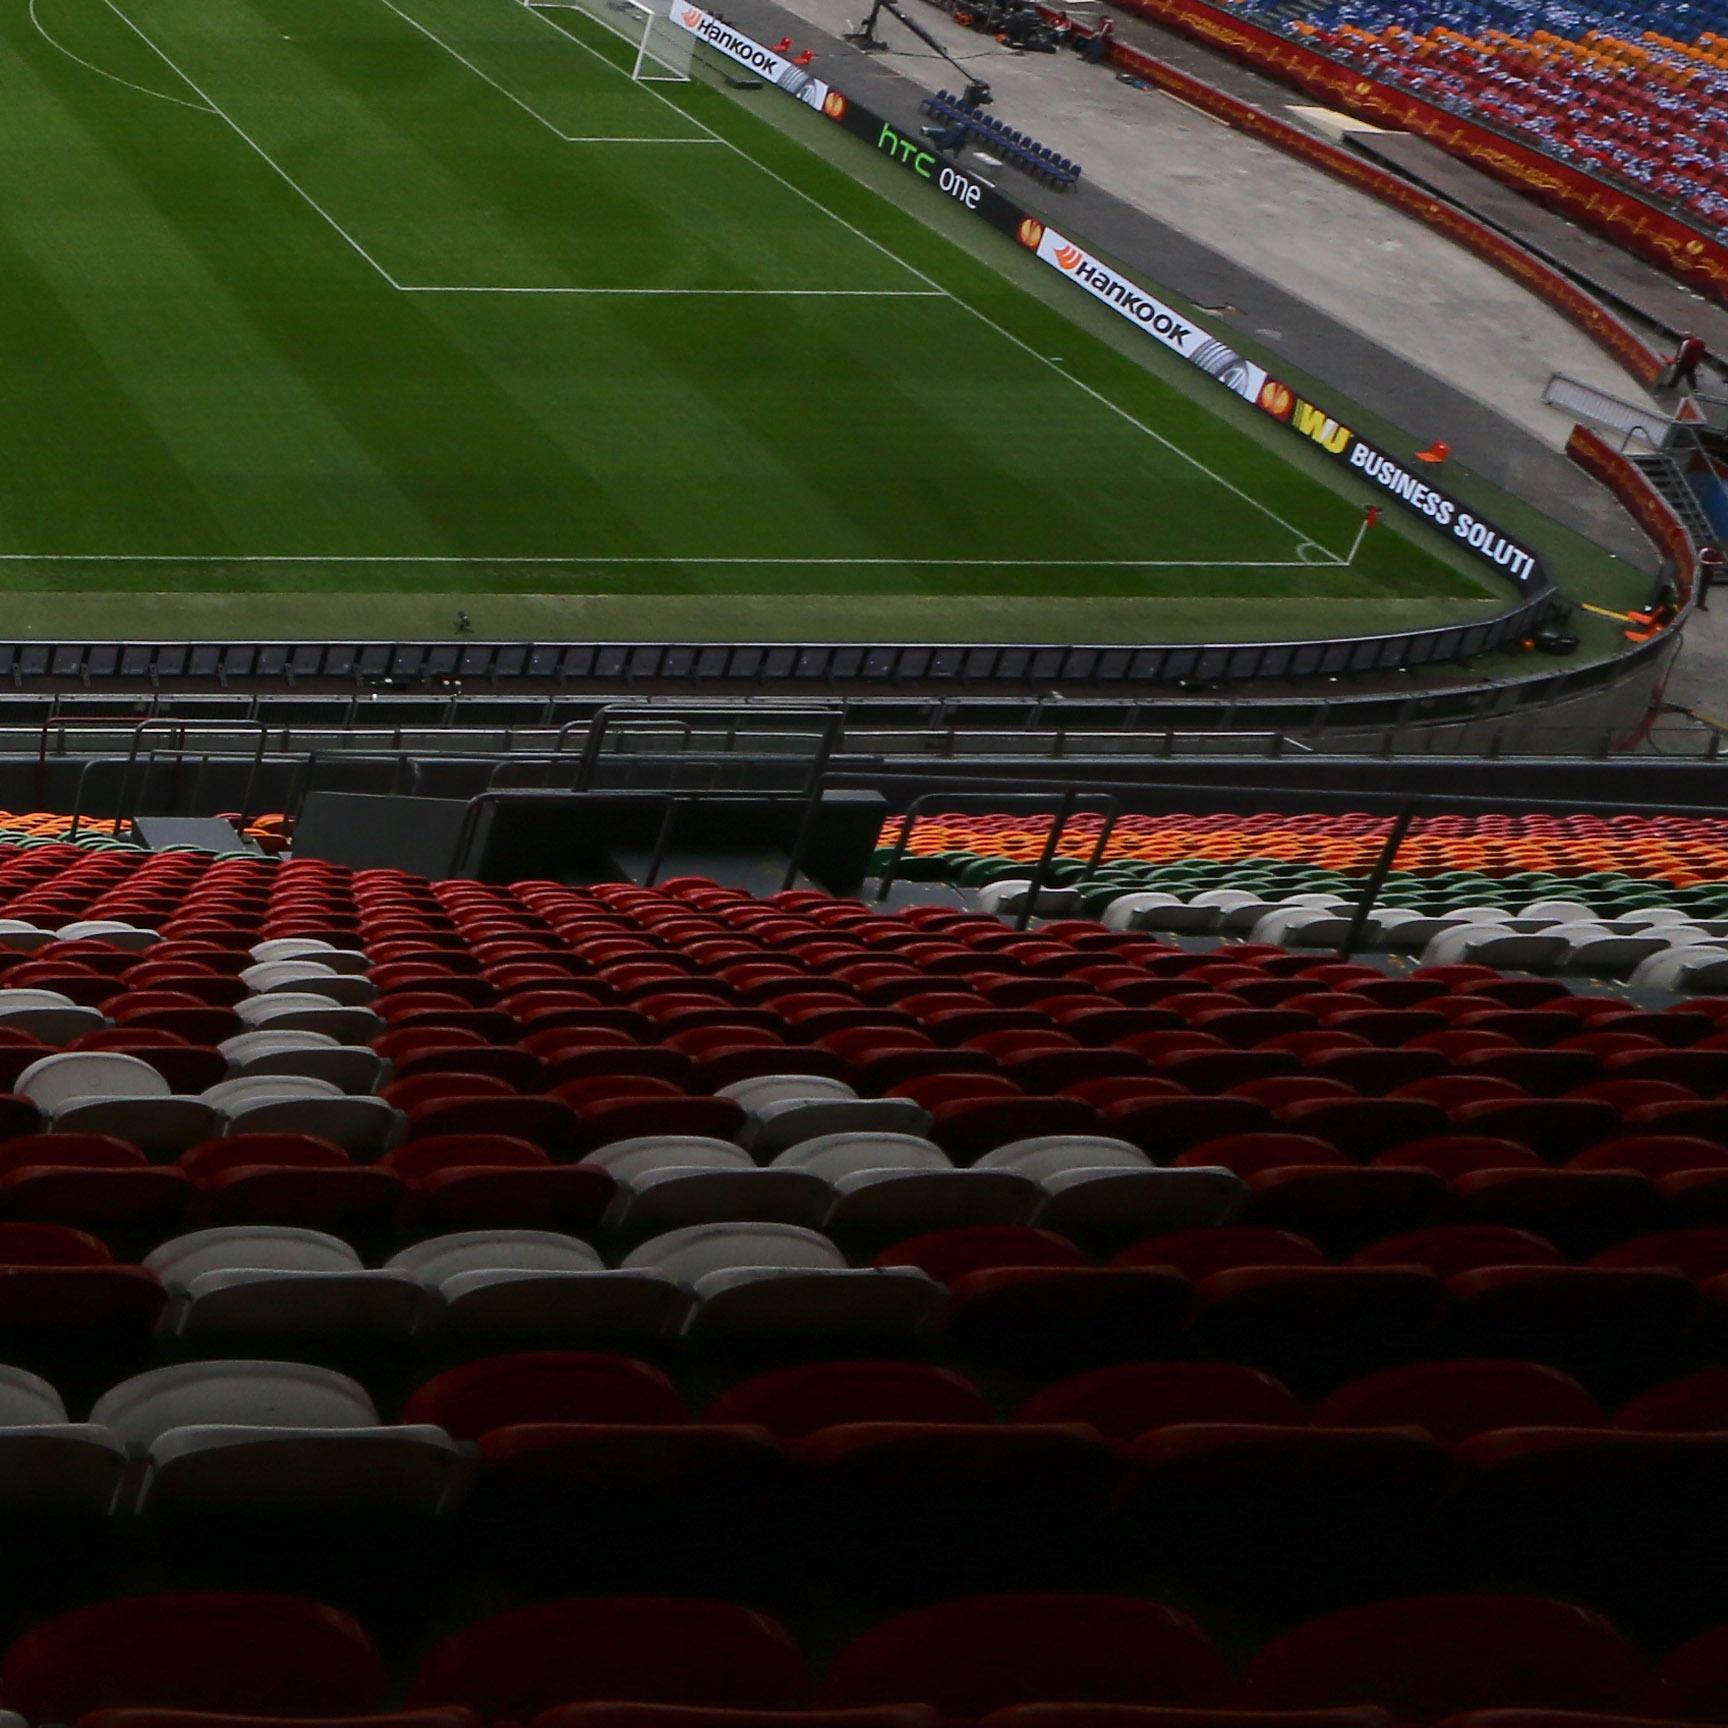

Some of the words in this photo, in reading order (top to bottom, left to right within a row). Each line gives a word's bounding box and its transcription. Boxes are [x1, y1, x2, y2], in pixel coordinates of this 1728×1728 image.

[939, 167, 981, 210] one
[1350, 442, 1455, 526] BUSINESS
[1454, 512, 1537, 581] SOLUTI
